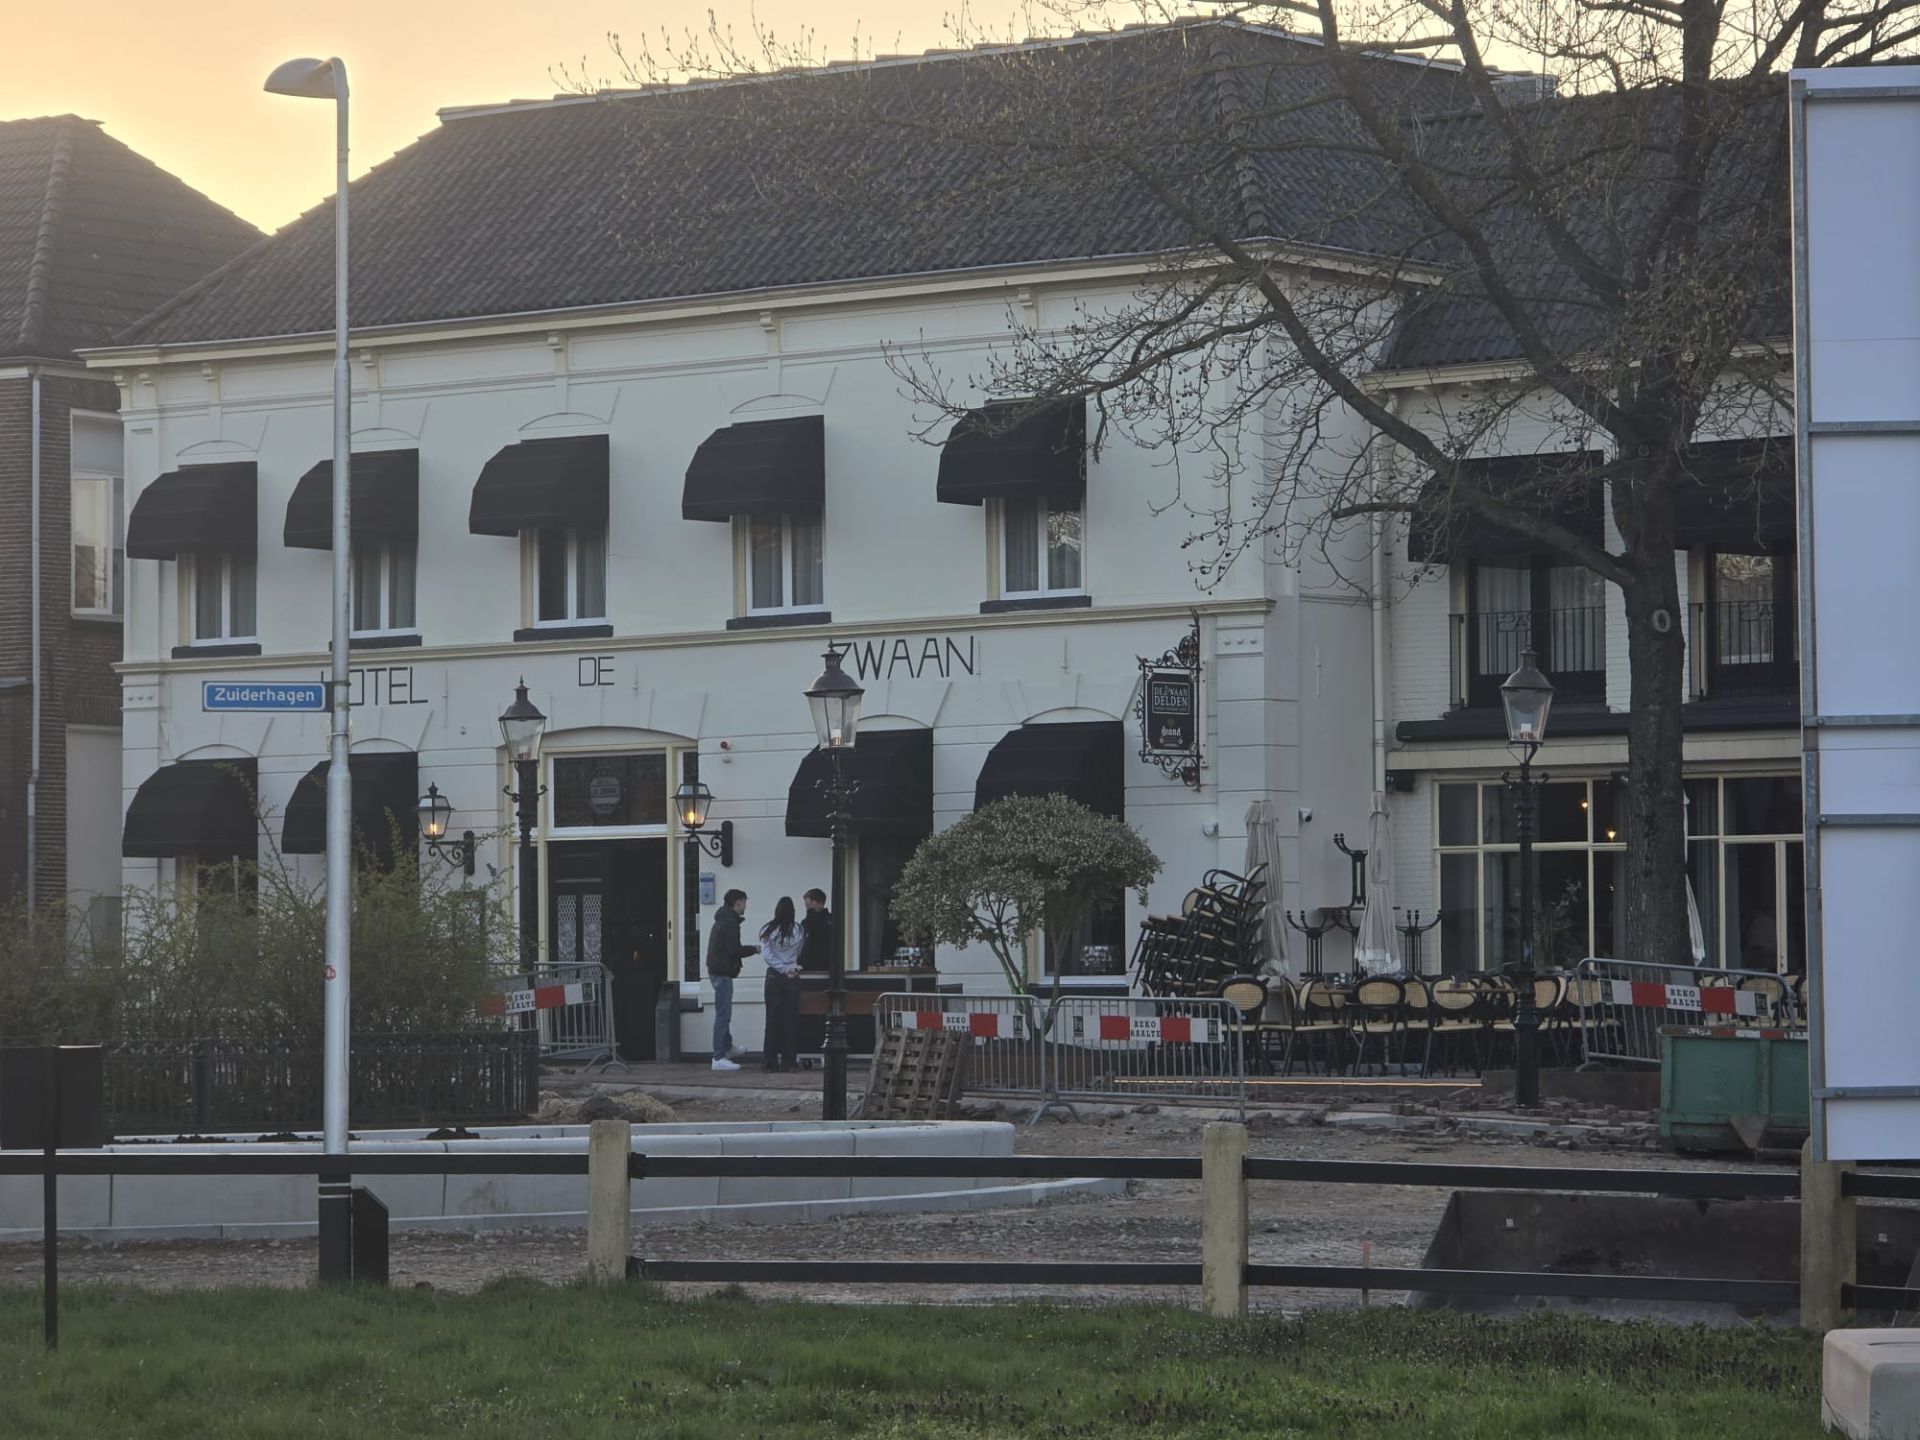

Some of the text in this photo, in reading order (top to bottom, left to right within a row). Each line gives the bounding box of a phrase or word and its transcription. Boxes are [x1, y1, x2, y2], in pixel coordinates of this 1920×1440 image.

[320, 666, 428, 706] OTEL
[578, 656, 614, 687] DE
[214, 687, 315, 705] Zuiderhagen
[1154, 696, 1188, 706] DELDEN
[1670, 988, 1695, 997] REKO
[1134, 1020, 1156, 1029] REKO
